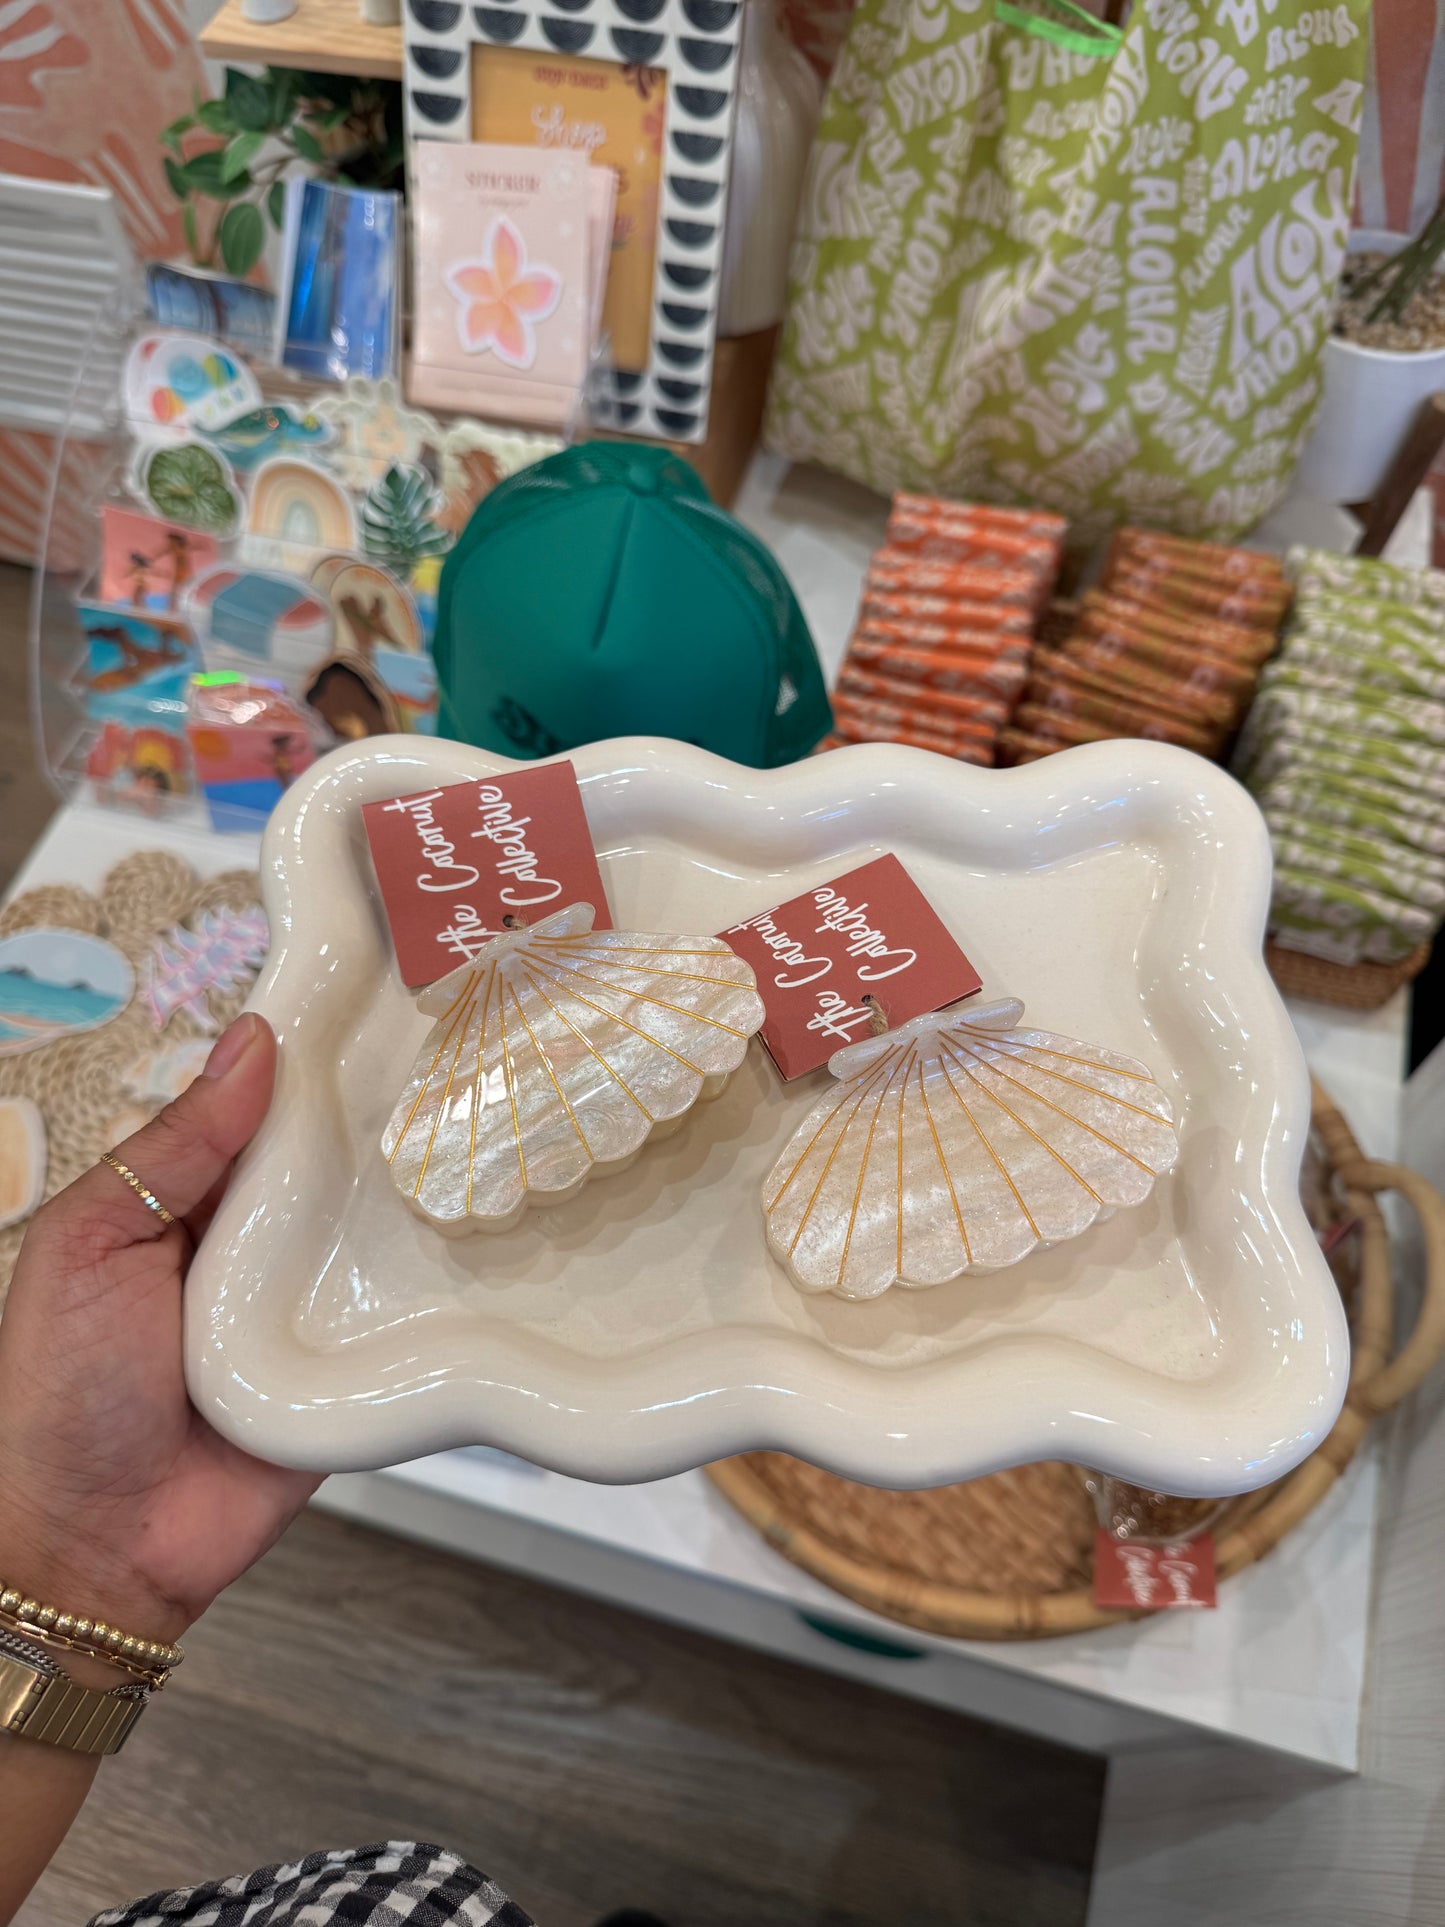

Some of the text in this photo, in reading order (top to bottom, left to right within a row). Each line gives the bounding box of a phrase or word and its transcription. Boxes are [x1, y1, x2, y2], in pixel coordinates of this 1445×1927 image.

[1125, 176, 1179, 365] ALOHA
[382, 791, 480, 893] Coconut
[470, 785, 563, 906] Collective
[727, 906, 833, 989] Coconut
[811, 887, 917, 982] Collective
